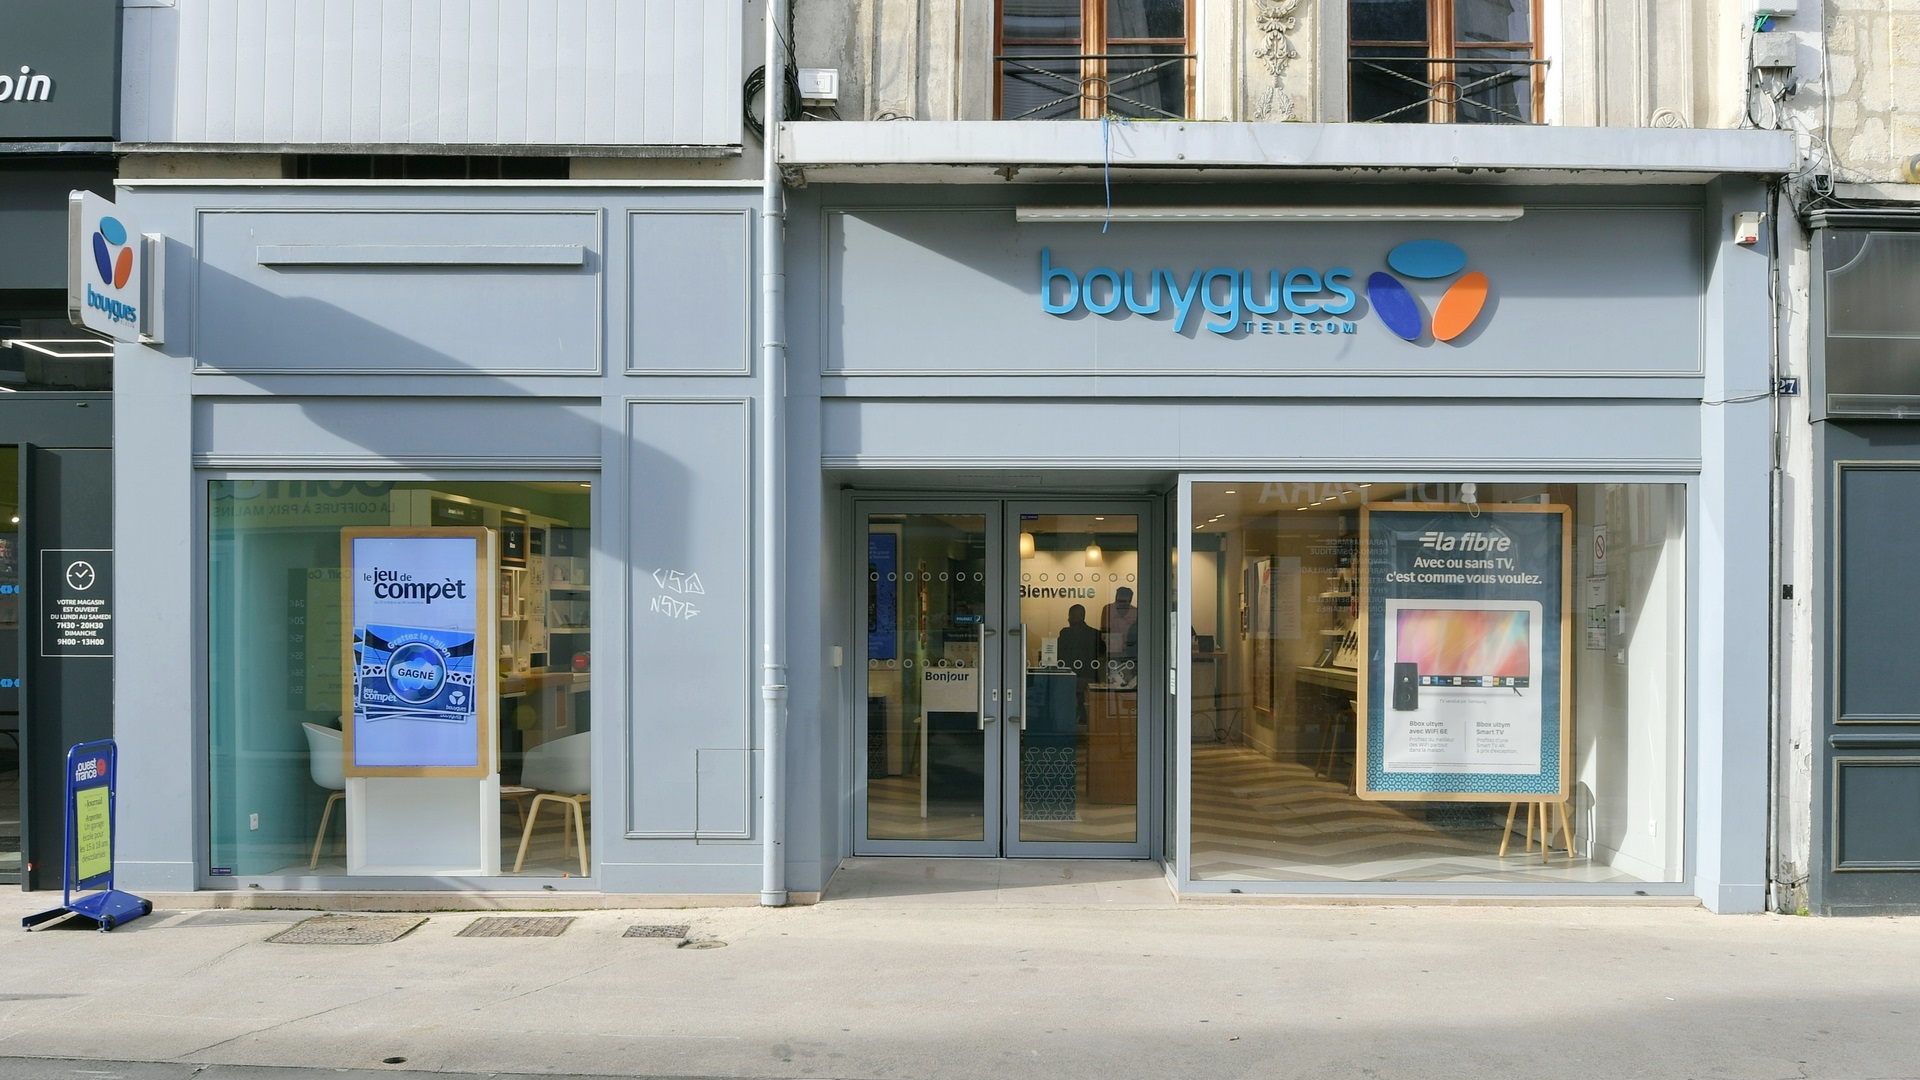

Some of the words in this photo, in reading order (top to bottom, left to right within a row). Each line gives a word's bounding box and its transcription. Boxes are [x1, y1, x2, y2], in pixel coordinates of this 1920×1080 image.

[1041, 247, 1355, 334] bouygues
[87, 282, 137, 323] bouygues
[1243, 320, 1358, 334] TELECOM
[1435, 531, 1455, 551] la
[1459, 532, 1511, 551] fibre
[1414, 557, 1445, 568] Avec
[1446, 560, 1463, 568] ou
[1464, 560, 1494, 569] sans
[1495, 558, 1515, 571] TV,
[363, 572, 372, 582] le
[373, 567, 397, 585] jeu
[400, 573, 412, 581] de
[1386, 571, 1416, 582] c'est
[1417, 573, 1465, 583] comme
[1465, 574, 1496, 584] vous
[1497, 572, 1542, 584] voulez.
[374, 577, 467, 604] compèt
[1020, 584, 1096, 599] Bienvenue
[387, 633, 419, 650] Grattez
[420, 632, 428, 641] le
[429, 635, 451, 658] ballon
[398, 668, 434, 680] GAGNÉ
[925, 671, 969, 683] Bonjour
[78, 758, 96, 771] ouest
[75, 768, 97, 782] france
